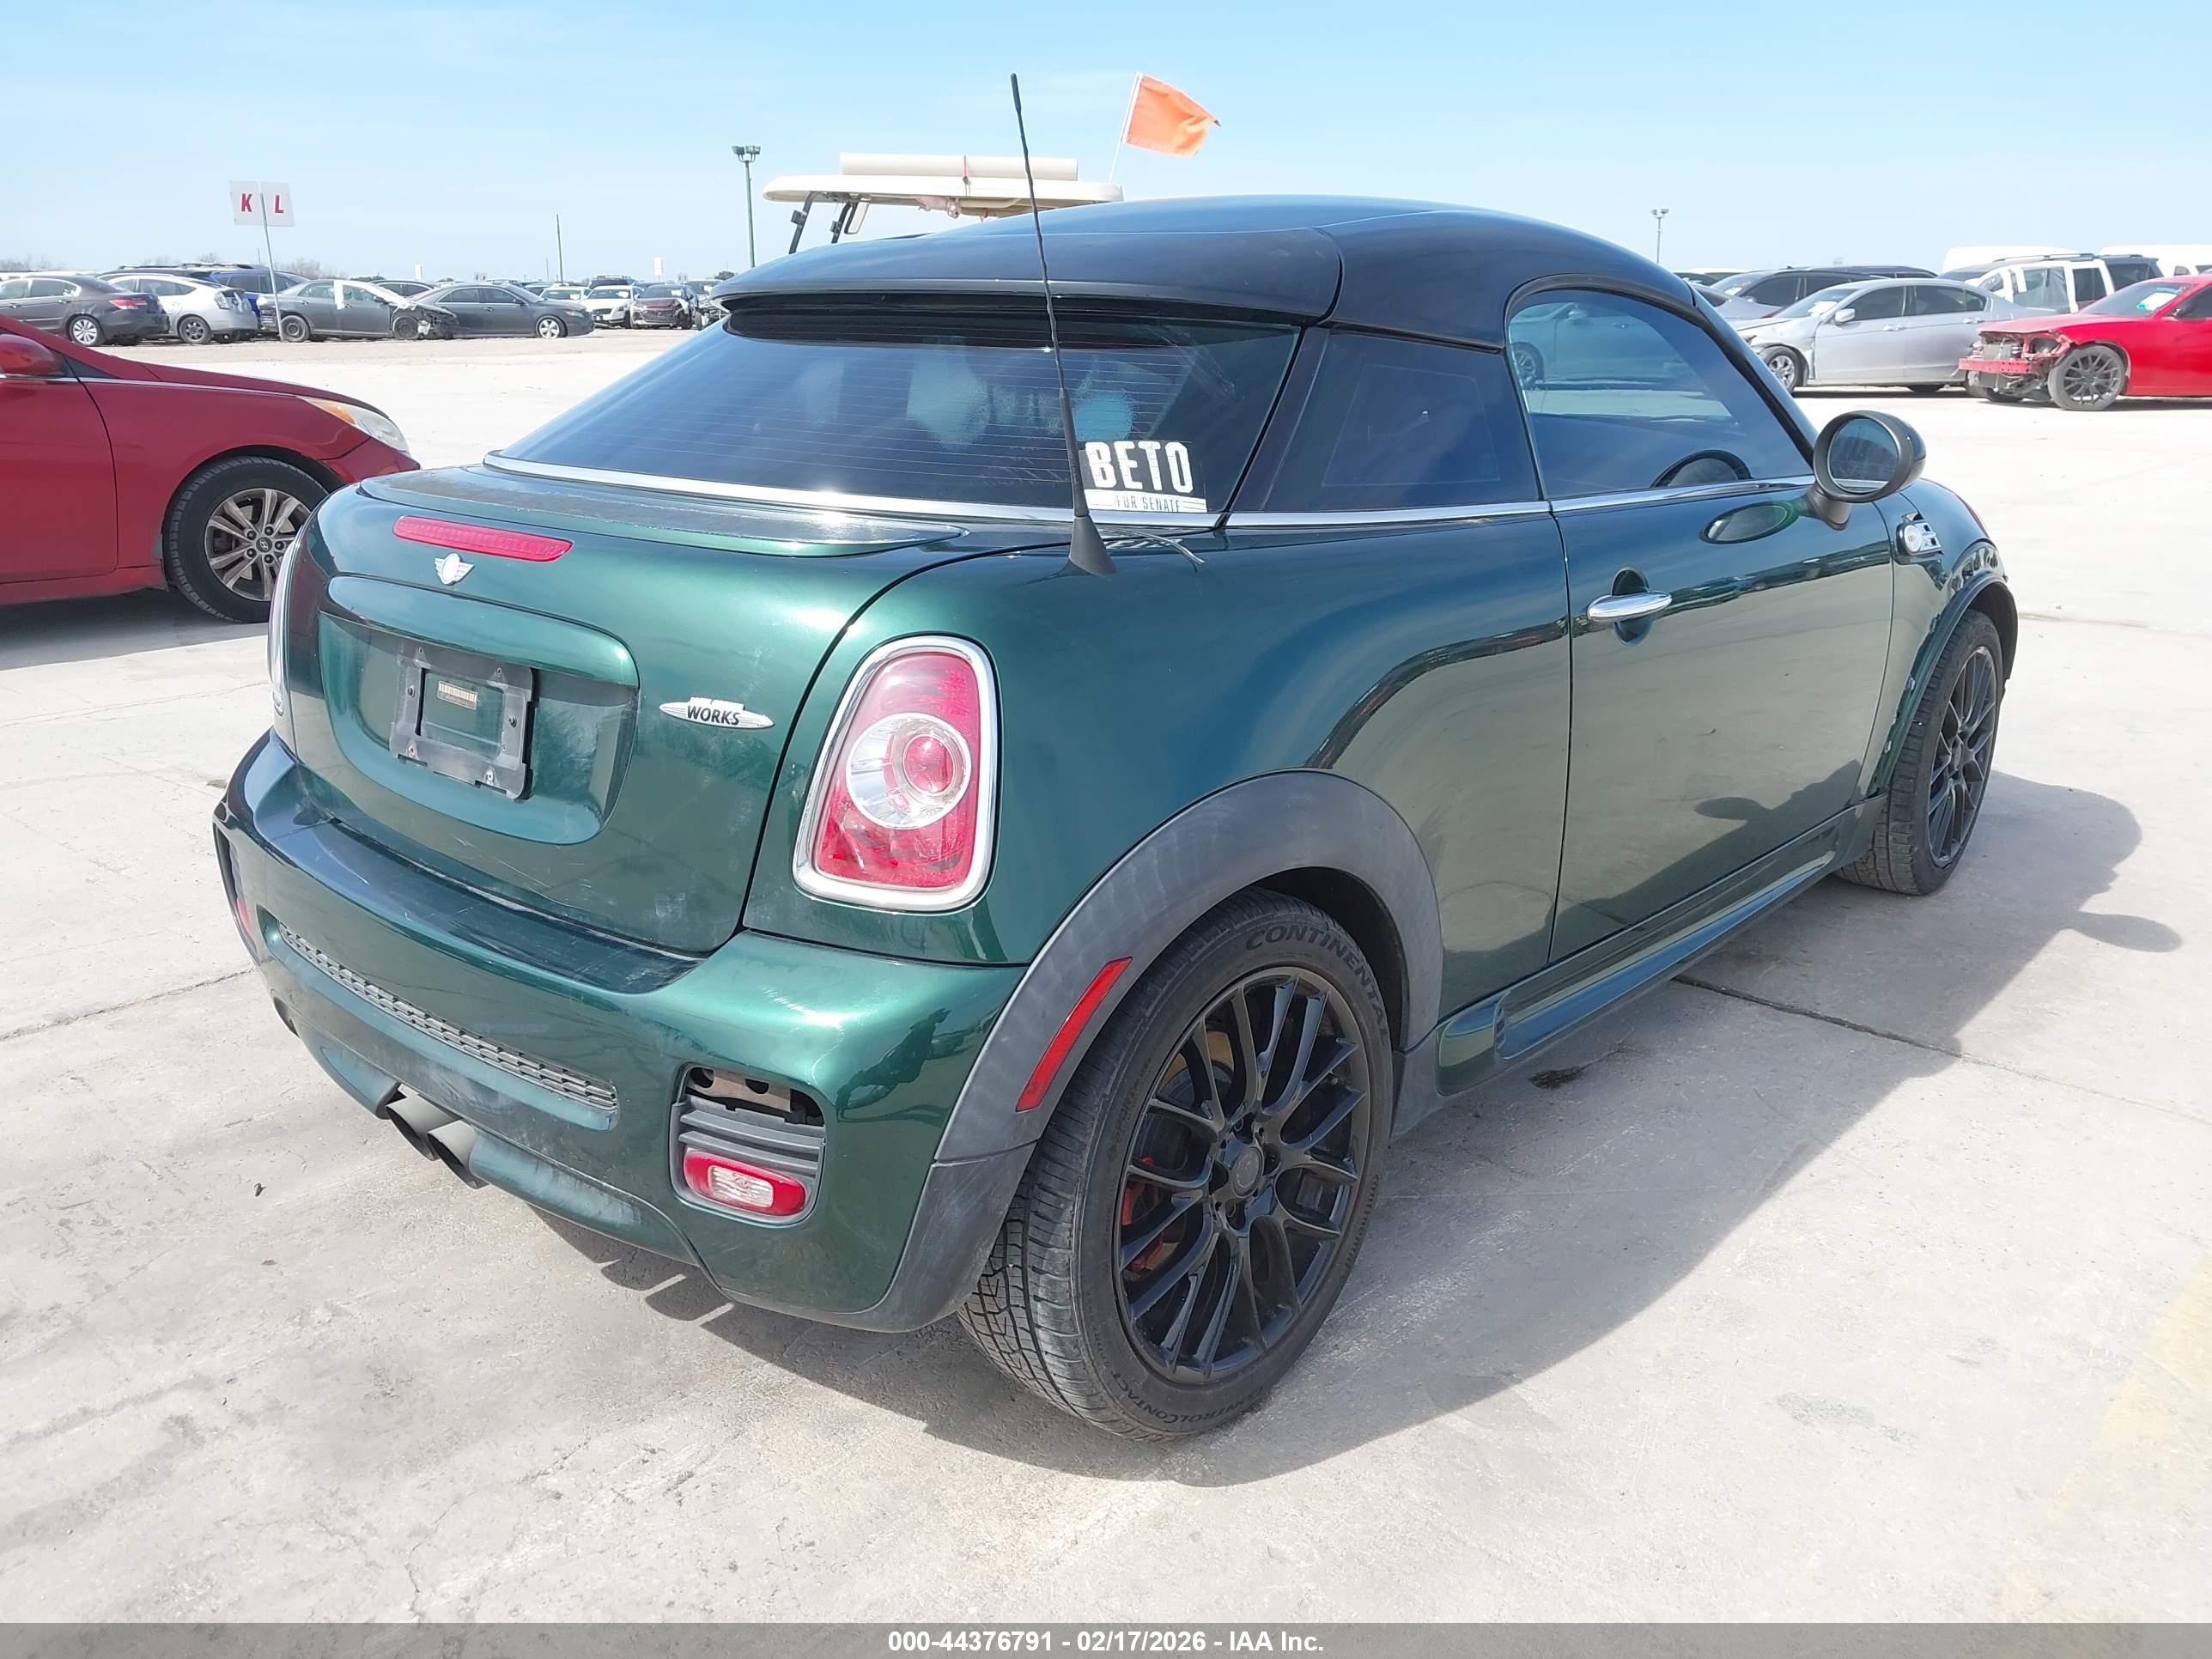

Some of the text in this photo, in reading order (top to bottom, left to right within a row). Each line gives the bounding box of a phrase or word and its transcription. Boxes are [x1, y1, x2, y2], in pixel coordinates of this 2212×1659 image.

[241, 193, 252, 213] K
[275, 195, 284, 214] L
[1085, 441, 1194, 494] BETO
[687, 705, 741, 726] WORKS
[1246, 924, 1388, 1045] CONTINENTAL
